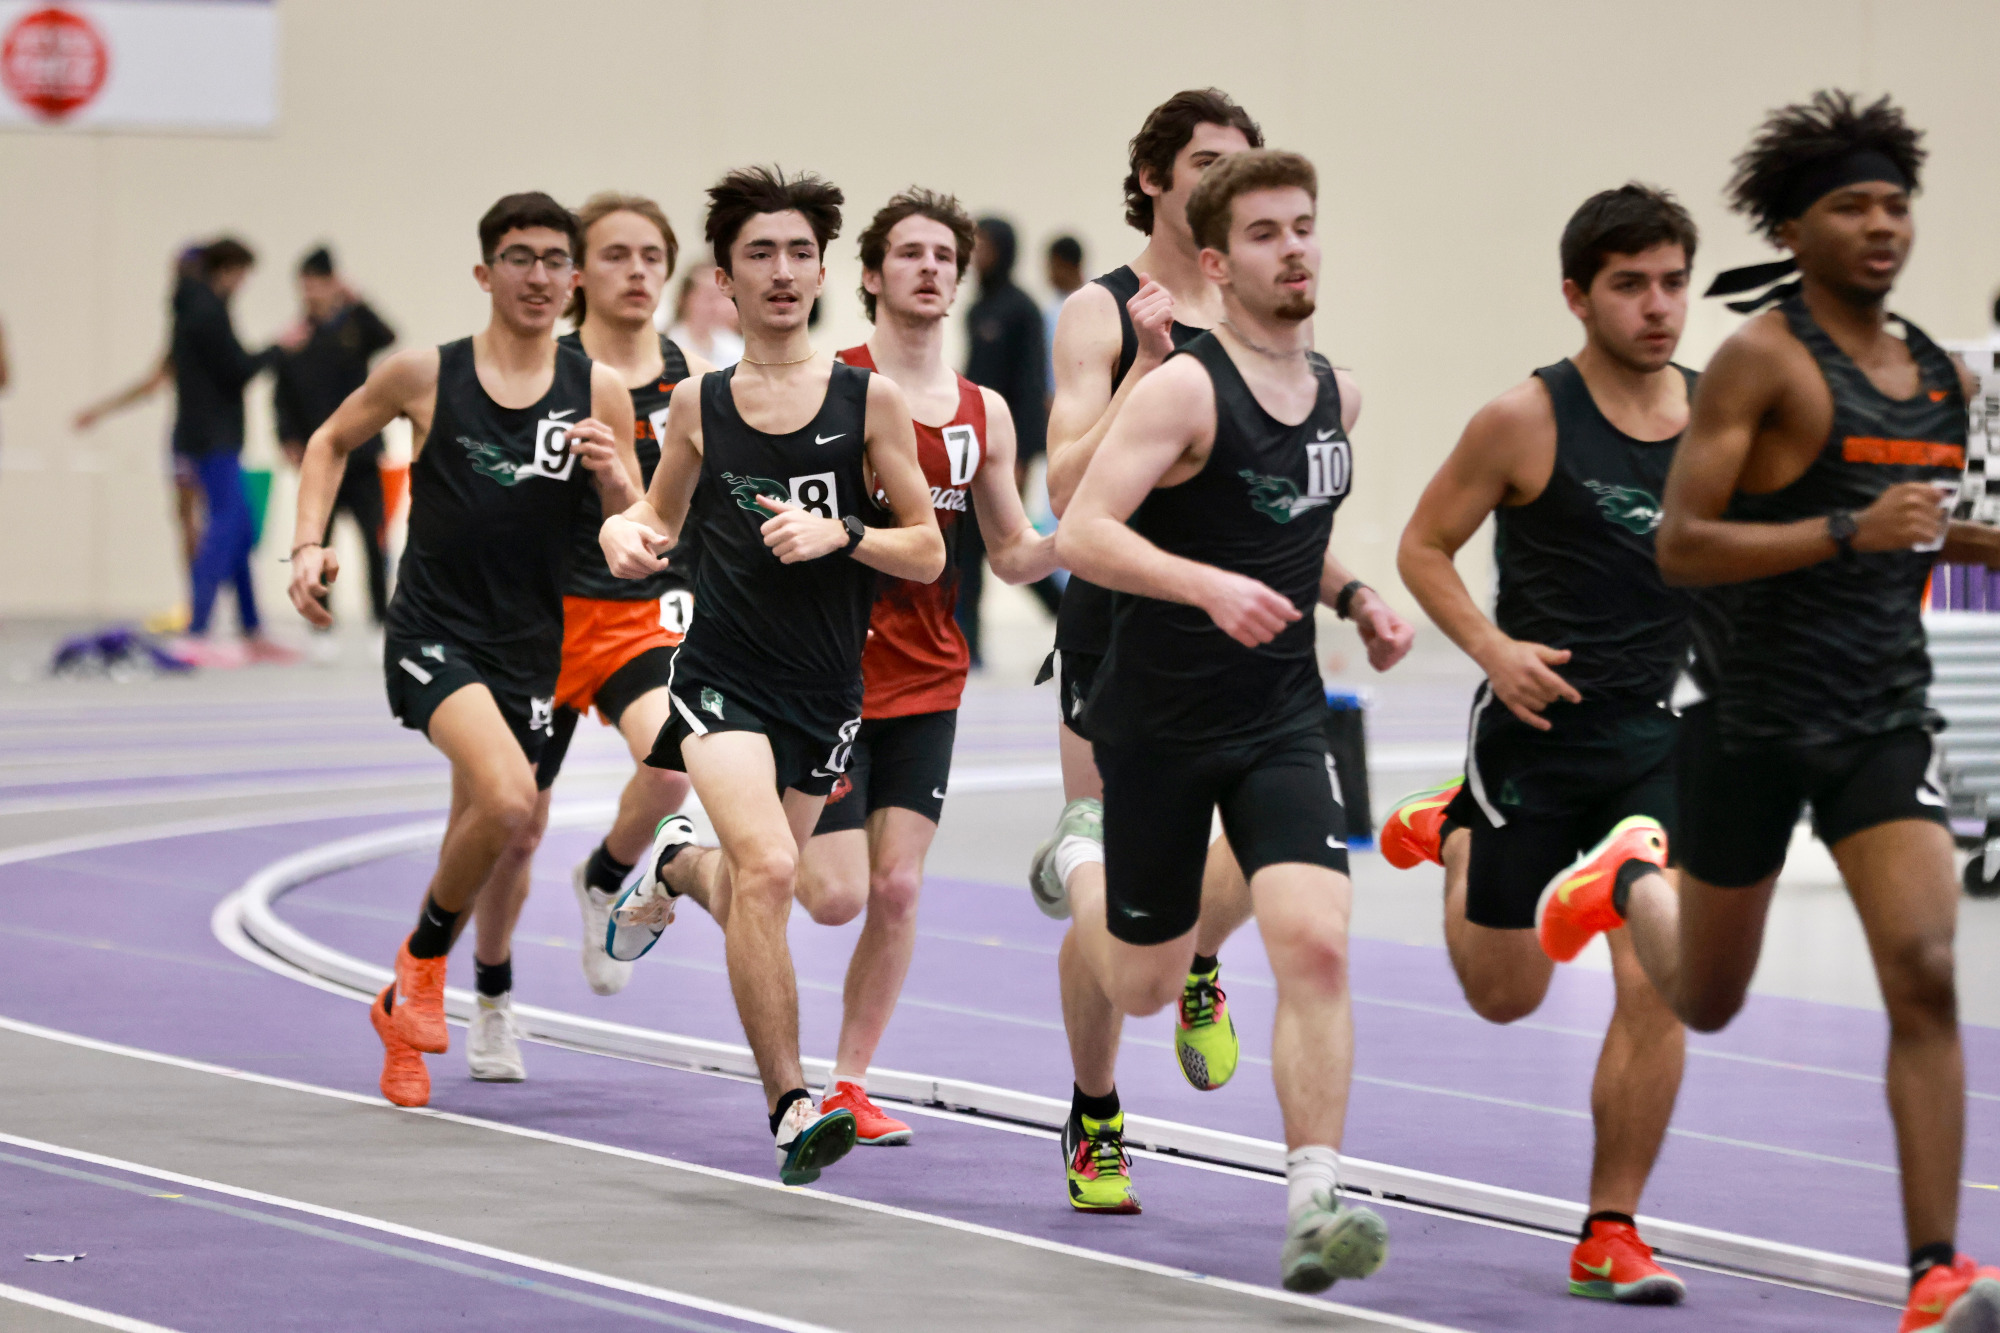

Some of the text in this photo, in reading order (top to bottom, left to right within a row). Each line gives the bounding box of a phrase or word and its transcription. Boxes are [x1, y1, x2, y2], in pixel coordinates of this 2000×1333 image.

[542, 426, 572, 474] 9
[947, 430, 971, 480] 7
[1313, 446, 1344, 493] 10
[798, 478, 833, 519] 8
